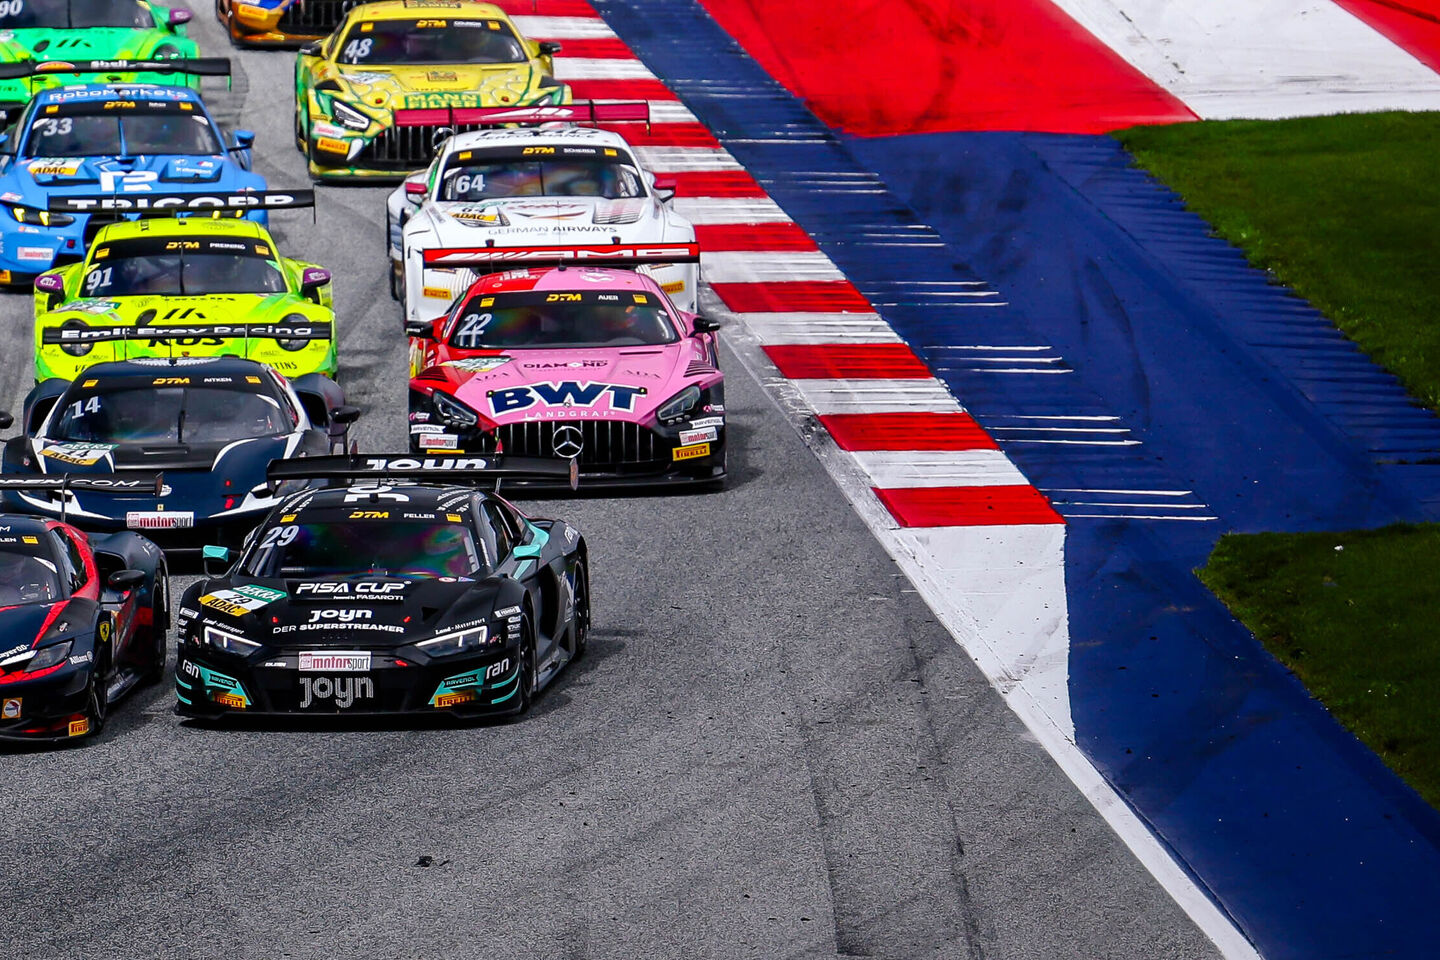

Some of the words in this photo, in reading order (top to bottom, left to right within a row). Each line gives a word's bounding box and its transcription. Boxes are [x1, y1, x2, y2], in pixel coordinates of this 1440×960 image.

[416, 20, 447, 28] DTM
[344, 38, 372, 58] 48
[49, 89, 188, 102] RoboMarkets
[407, 93, 478, 102] MANN
[104, 101, 137, 109] DTM
[43, 118, 73, 136] 33
[523, 147, 556, 155] DTM
[34, 167, 67, 175] ADAC
[455, 174, 485, 193] 64
[451, 213, 486, 221] ADAC
[488, 226, 549, 235] GERMAN
[166, 242, 200, 250] DTM
[86, 268, 112, 290] 91
[546, 293, 582, 302] DTM
[457, 313, 493, 337] 22
[153, 377, 190, 385] DTM
[488, 381, 647, 417] BWT
[70, 396, 101, 419] 14
[525, 410, 612, 419] LANDGRAF
[675, 445, 708, 458] PIRELLI
[50, 453, 87, 465] ADAC
[349, 511, 389, 519] DTM
[139, 516, 193, 529] motorsport
[259, 525, 300, 548] 29
[237, 585, 282, 600] DEKRA
[296, 582, 349, 594] PISA
[205, 599, 242, 614] ADAC
[308, 609, 373, 623] joyn
[272, 625, 297, 634] DER
[299, 623, 405, 634] SUPERSTREAMER
[182, 659, 200, 679] ran
[312, 656, 370, 670] motorsport
[485, 657, 510, 680] ran
[299, 676, 374, 709] joyn
